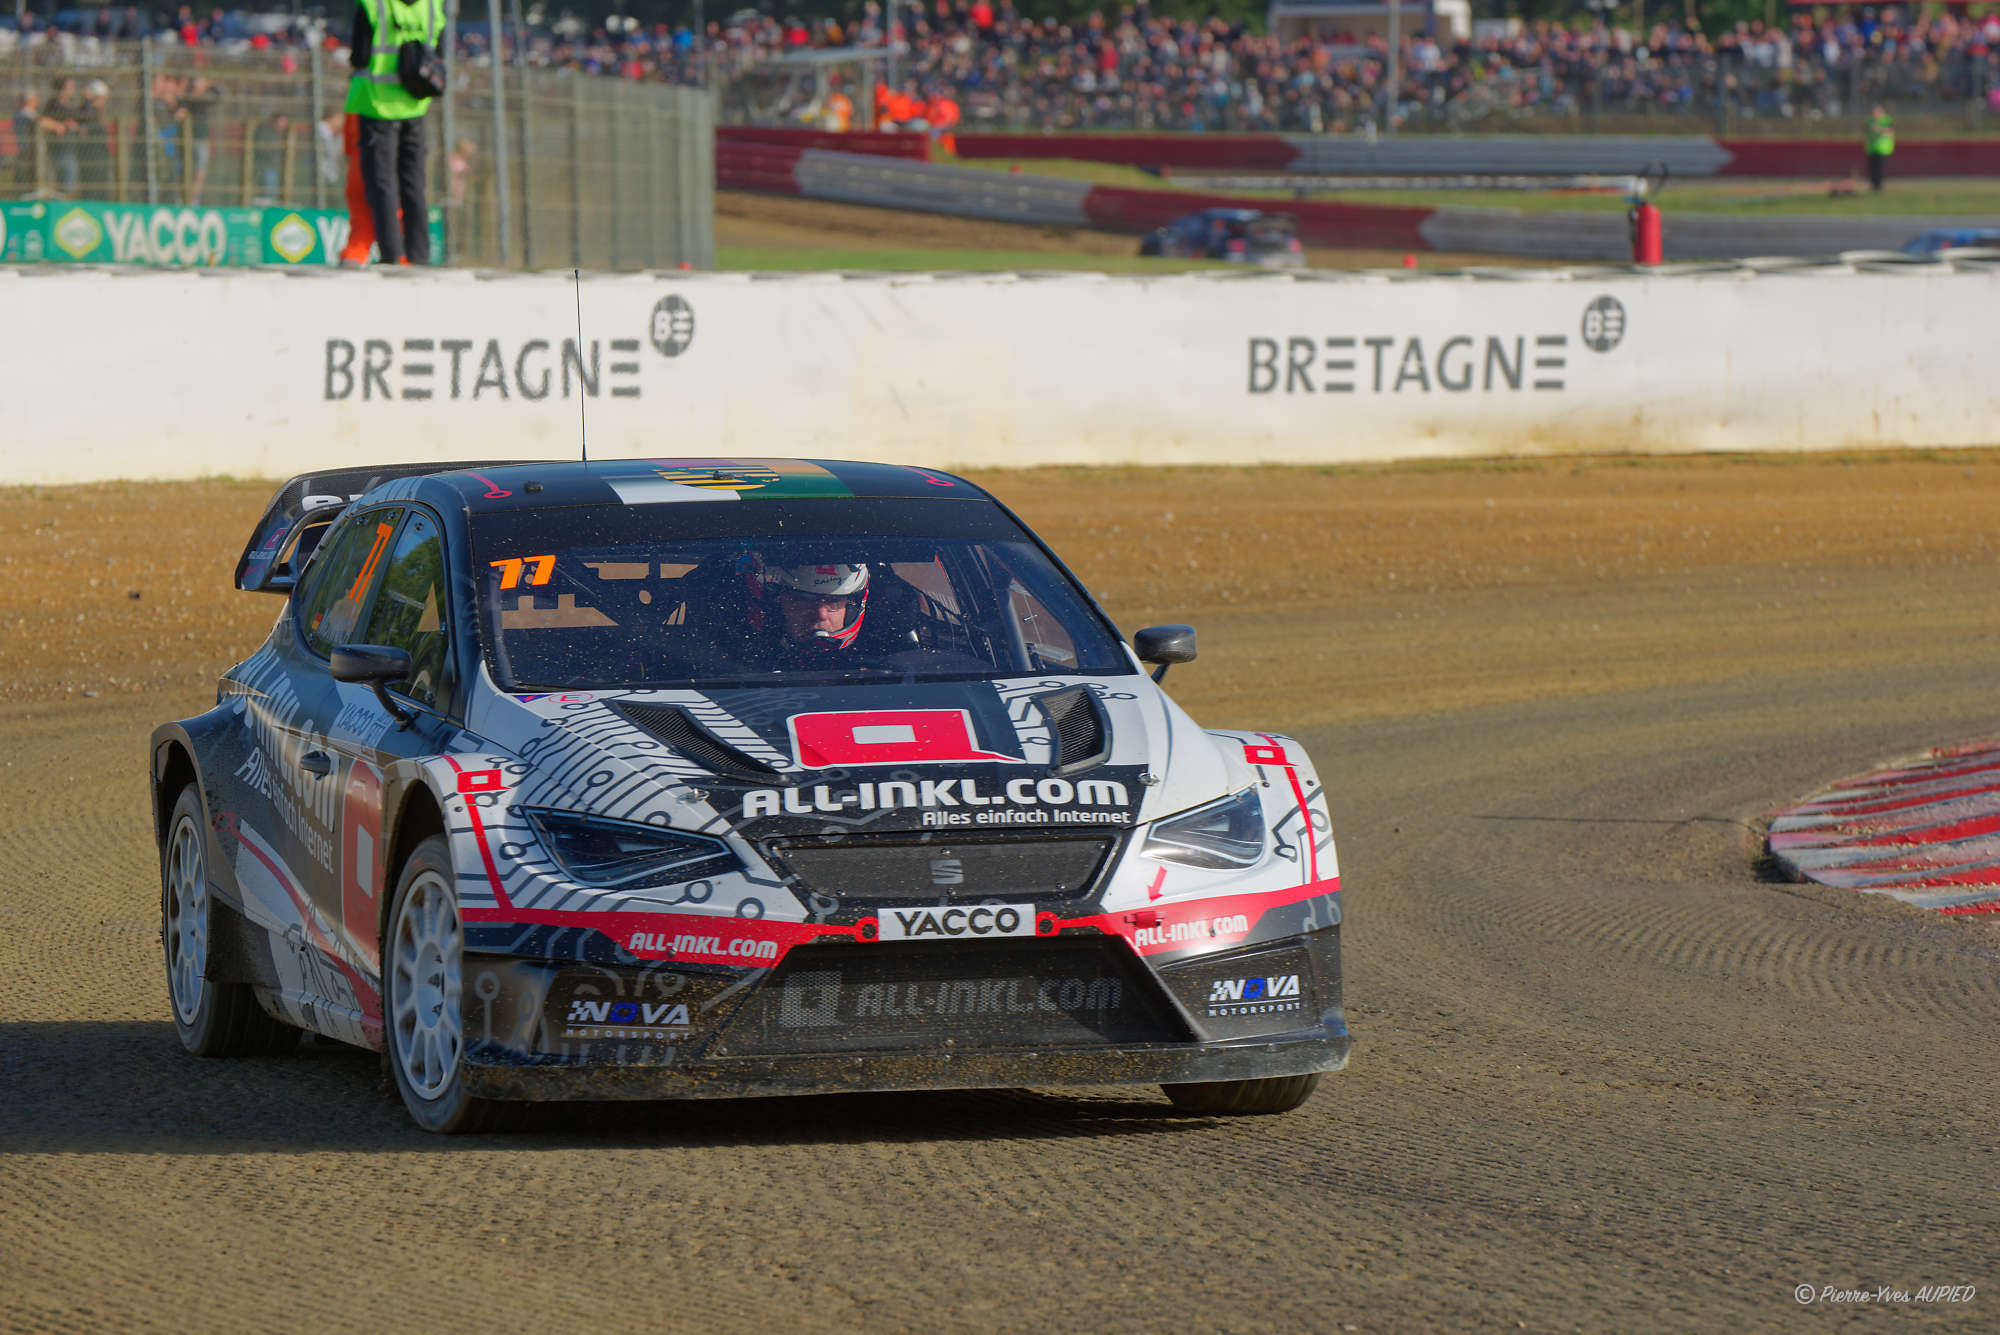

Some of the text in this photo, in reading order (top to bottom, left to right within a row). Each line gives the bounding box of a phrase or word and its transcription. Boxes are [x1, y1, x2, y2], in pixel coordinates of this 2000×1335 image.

[103, 208, 227, 264] YACCO
[324, 338, 641, 401] BRETAGNE
[1247, 335, 1567, 393] BRETAGNE
[489, 554, 556, 590] 77
[922, 808, 1131, 826] Alles einfach Internet
[894, 907, 1020, 937] YACCO
[1209, 974, 1300, 1001] NOVA
[567, 1000, 690, 1025] NOVA
[1208, 1002, 1301, 1017] MOTORSPORT
[565, 1029, 690, 1040] MOTORSPORT
